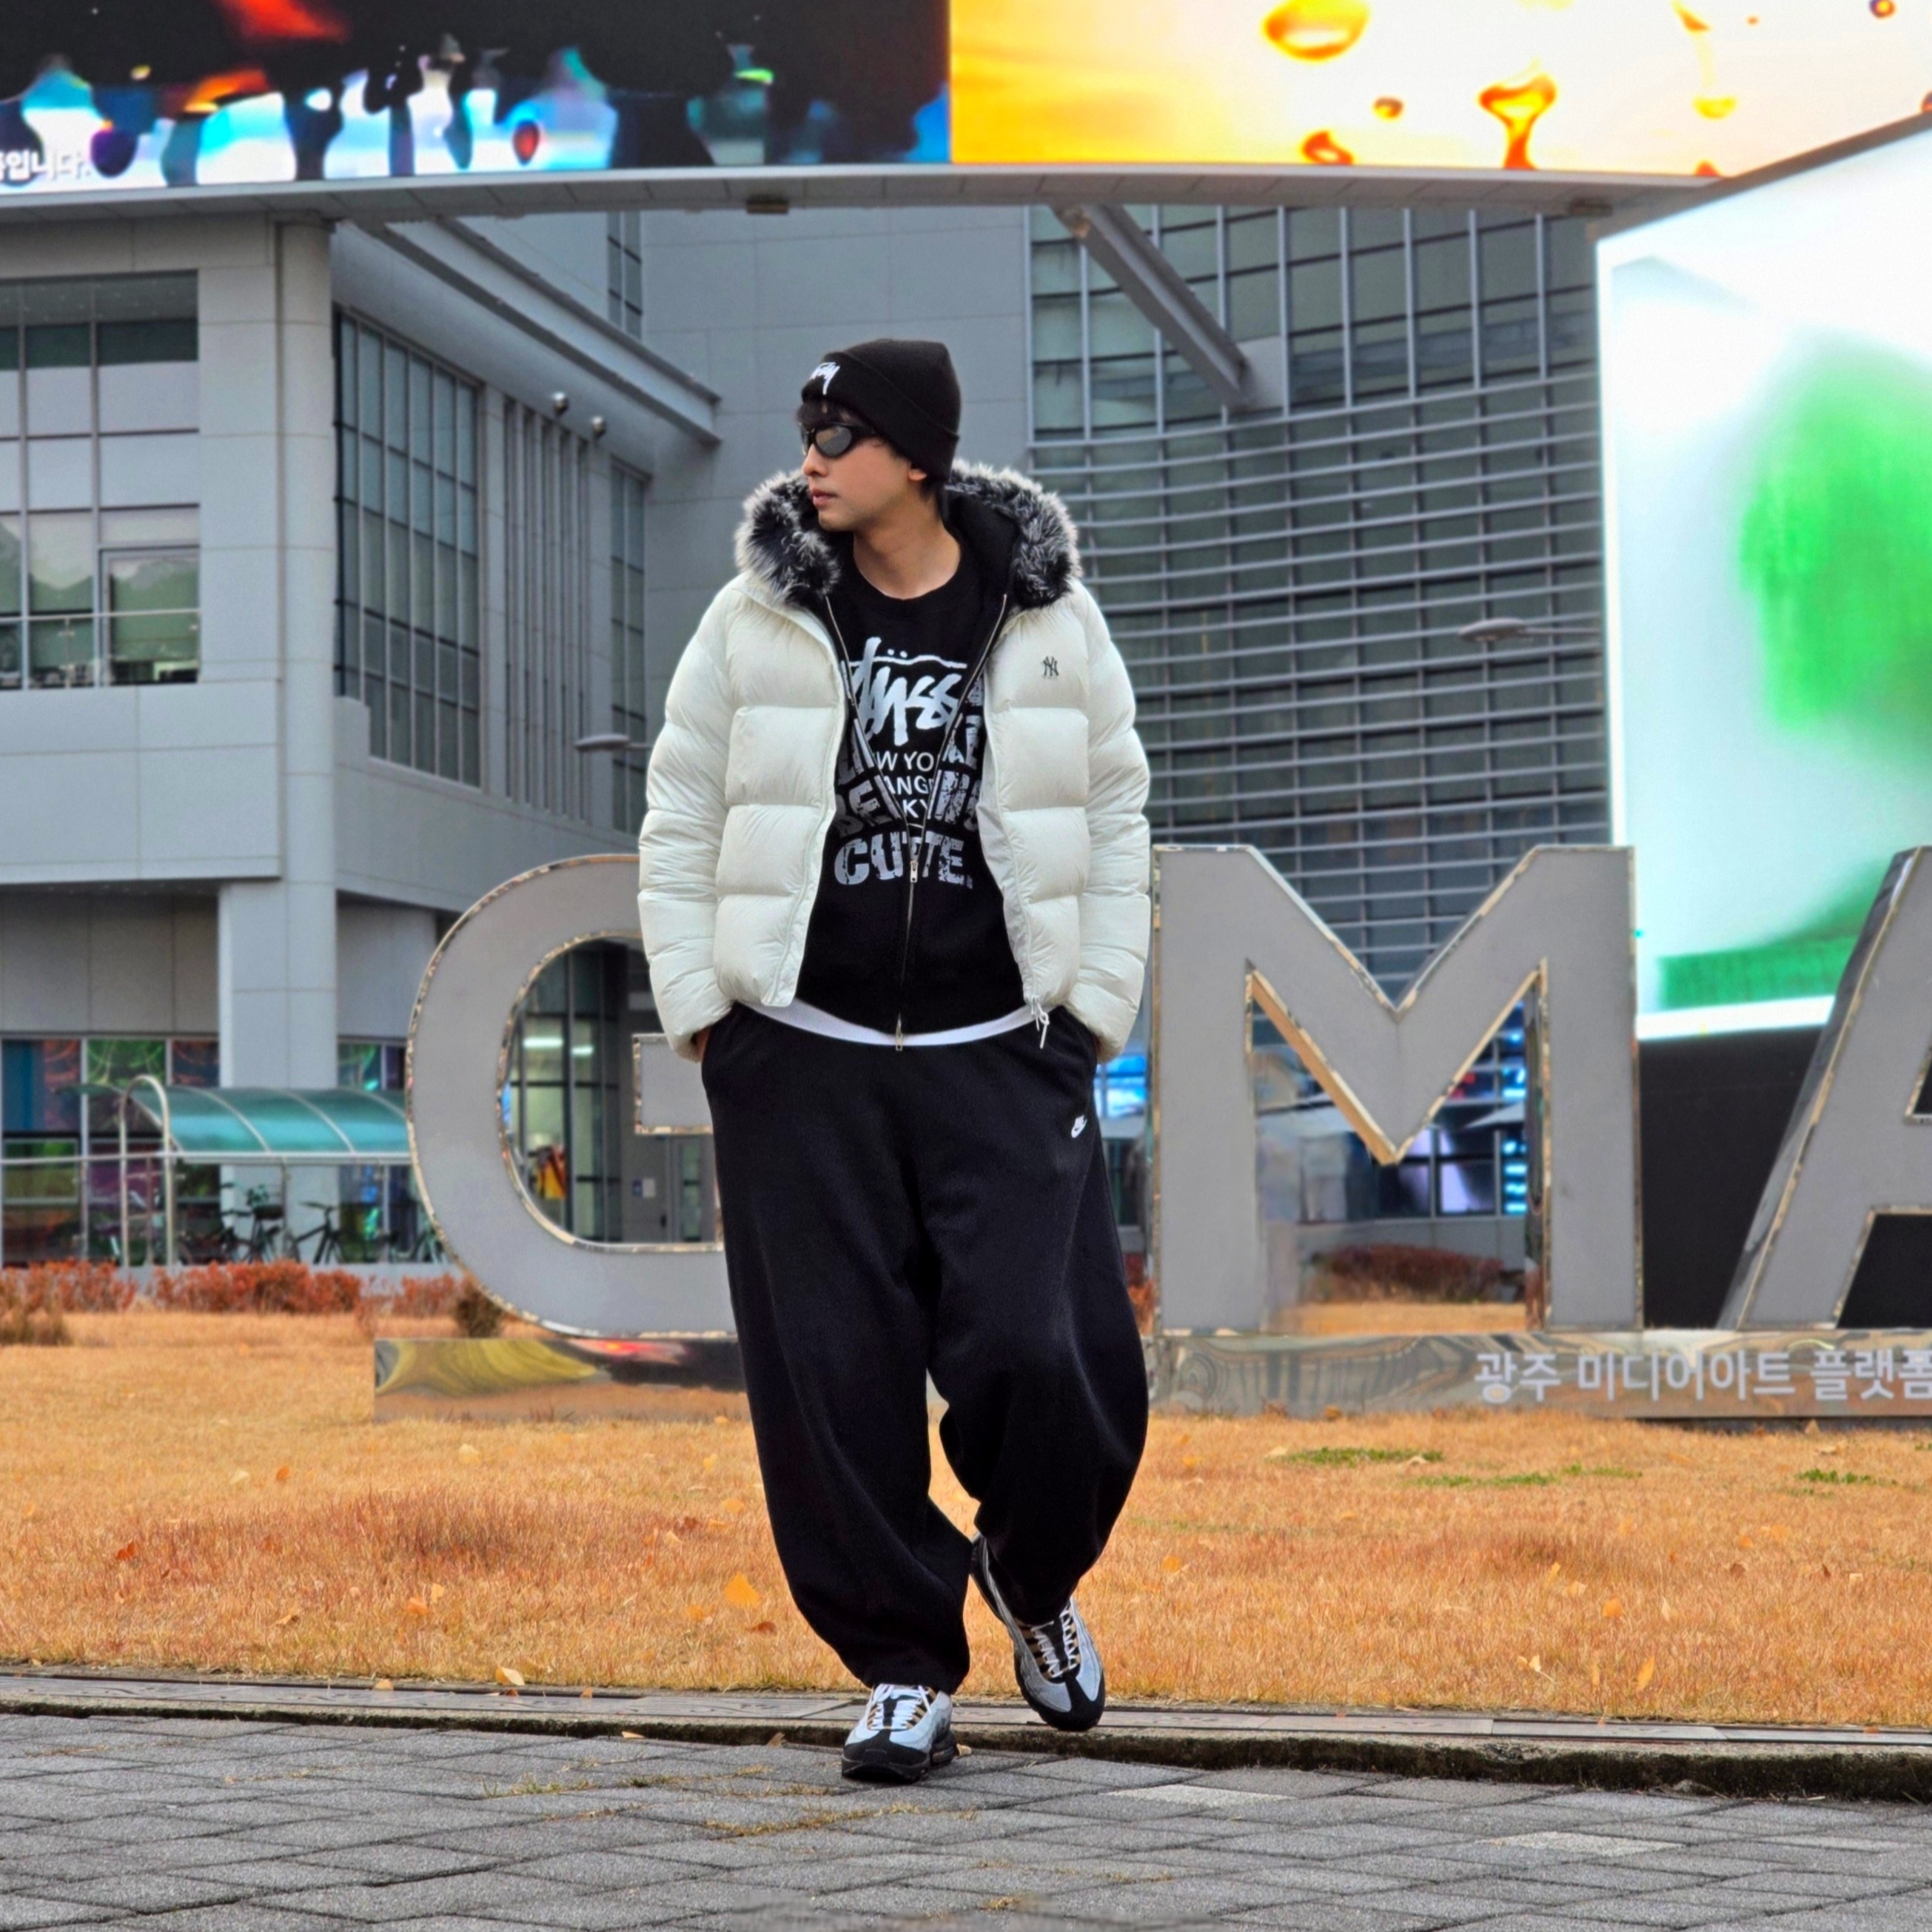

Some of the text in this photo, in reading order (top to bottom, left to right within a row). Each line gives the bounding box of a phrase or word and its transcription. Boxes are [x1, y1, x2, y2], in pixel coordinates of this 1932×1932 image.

[1474, 1349, 1932, 1403] 광주 미디어아트 플랫폼
